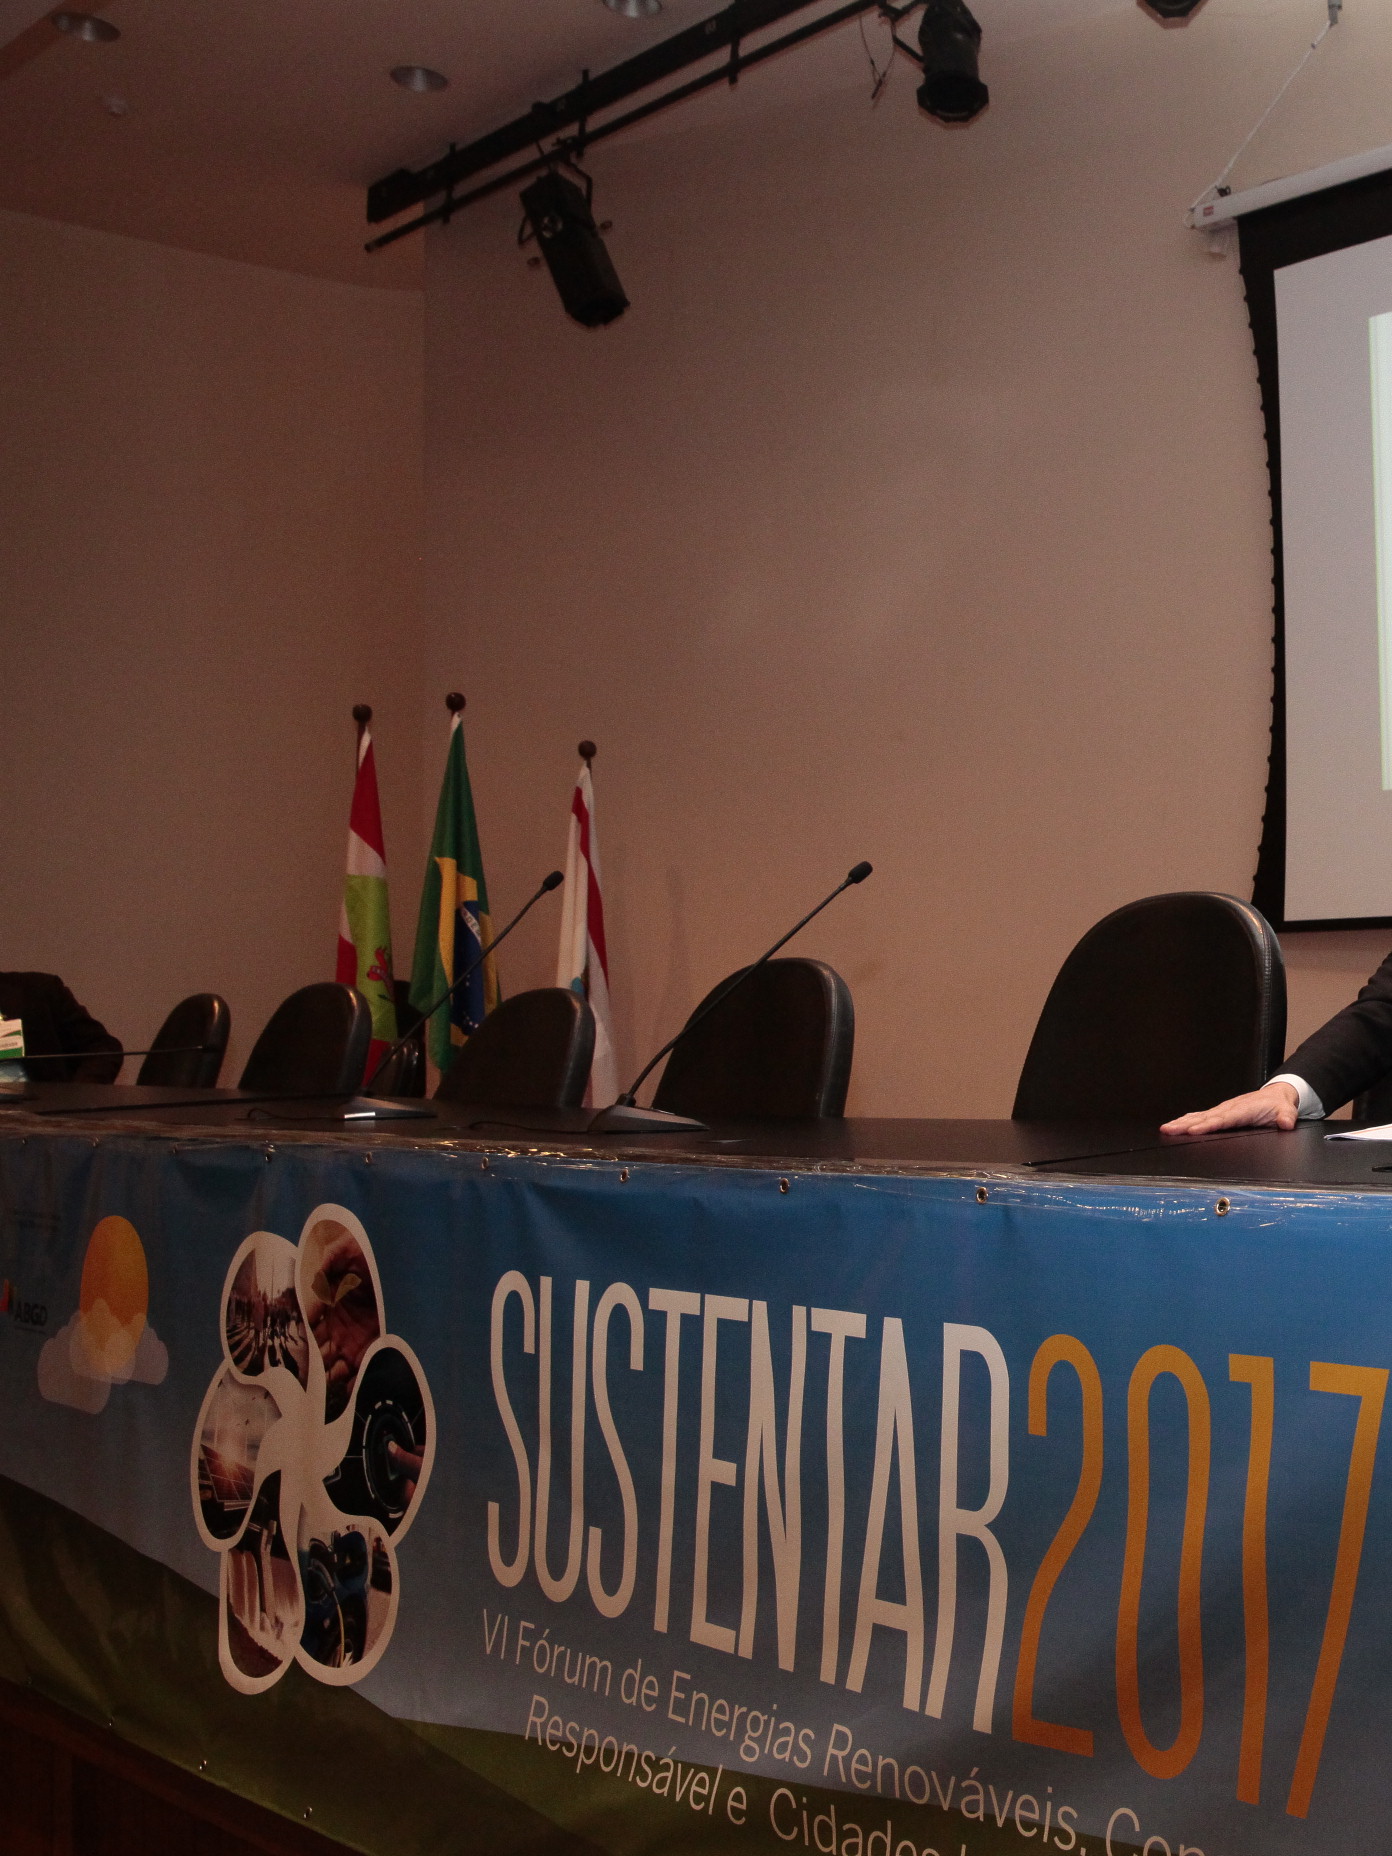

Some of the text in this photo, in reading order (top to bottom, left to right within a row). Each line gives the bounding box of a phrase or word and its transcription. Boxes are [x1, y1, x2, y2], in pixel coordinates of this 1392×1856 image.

[483, 1608, 509, 1660] VI
[515, 1620, 613, 1697] Fórum
[621, 1658, 659, 1712] de
[667, 1670, 815, 1768] Energias
[524, 1694, 723, 1816] Responsável
[727, 1786, 747, 1826] e
